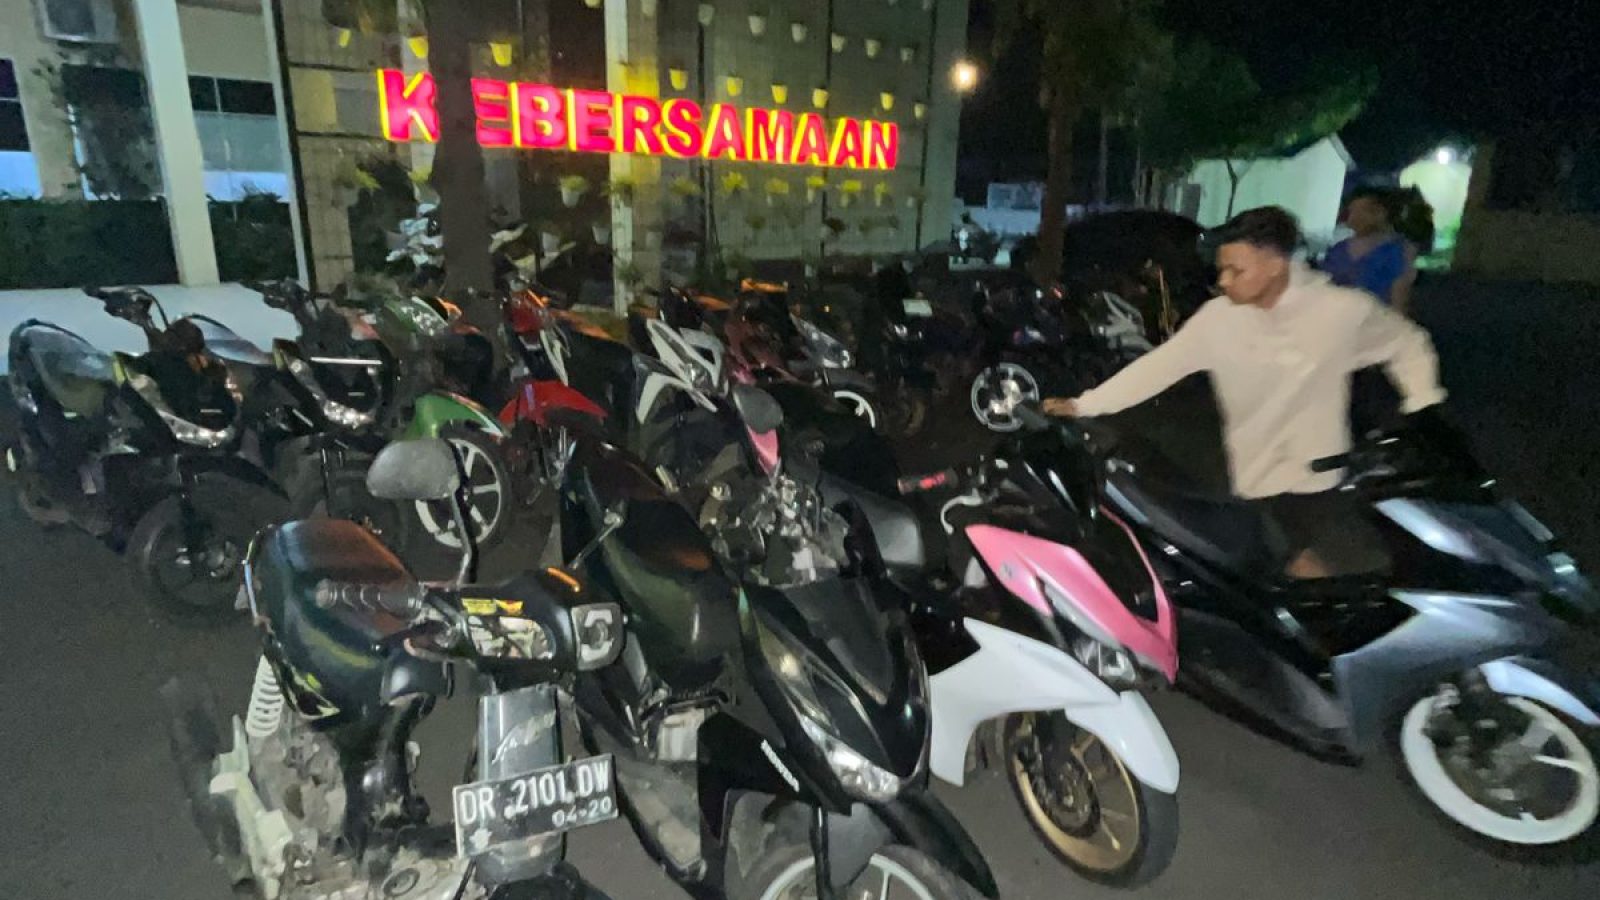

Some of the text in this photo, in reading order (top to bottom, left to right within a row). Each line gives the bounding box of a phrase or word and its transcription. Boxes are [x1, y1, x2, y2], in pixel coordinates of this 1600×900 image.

[376, 68, 899, 170] KEBERSAMAAN
[459, 760, 609, 825] DR 2101 DW
